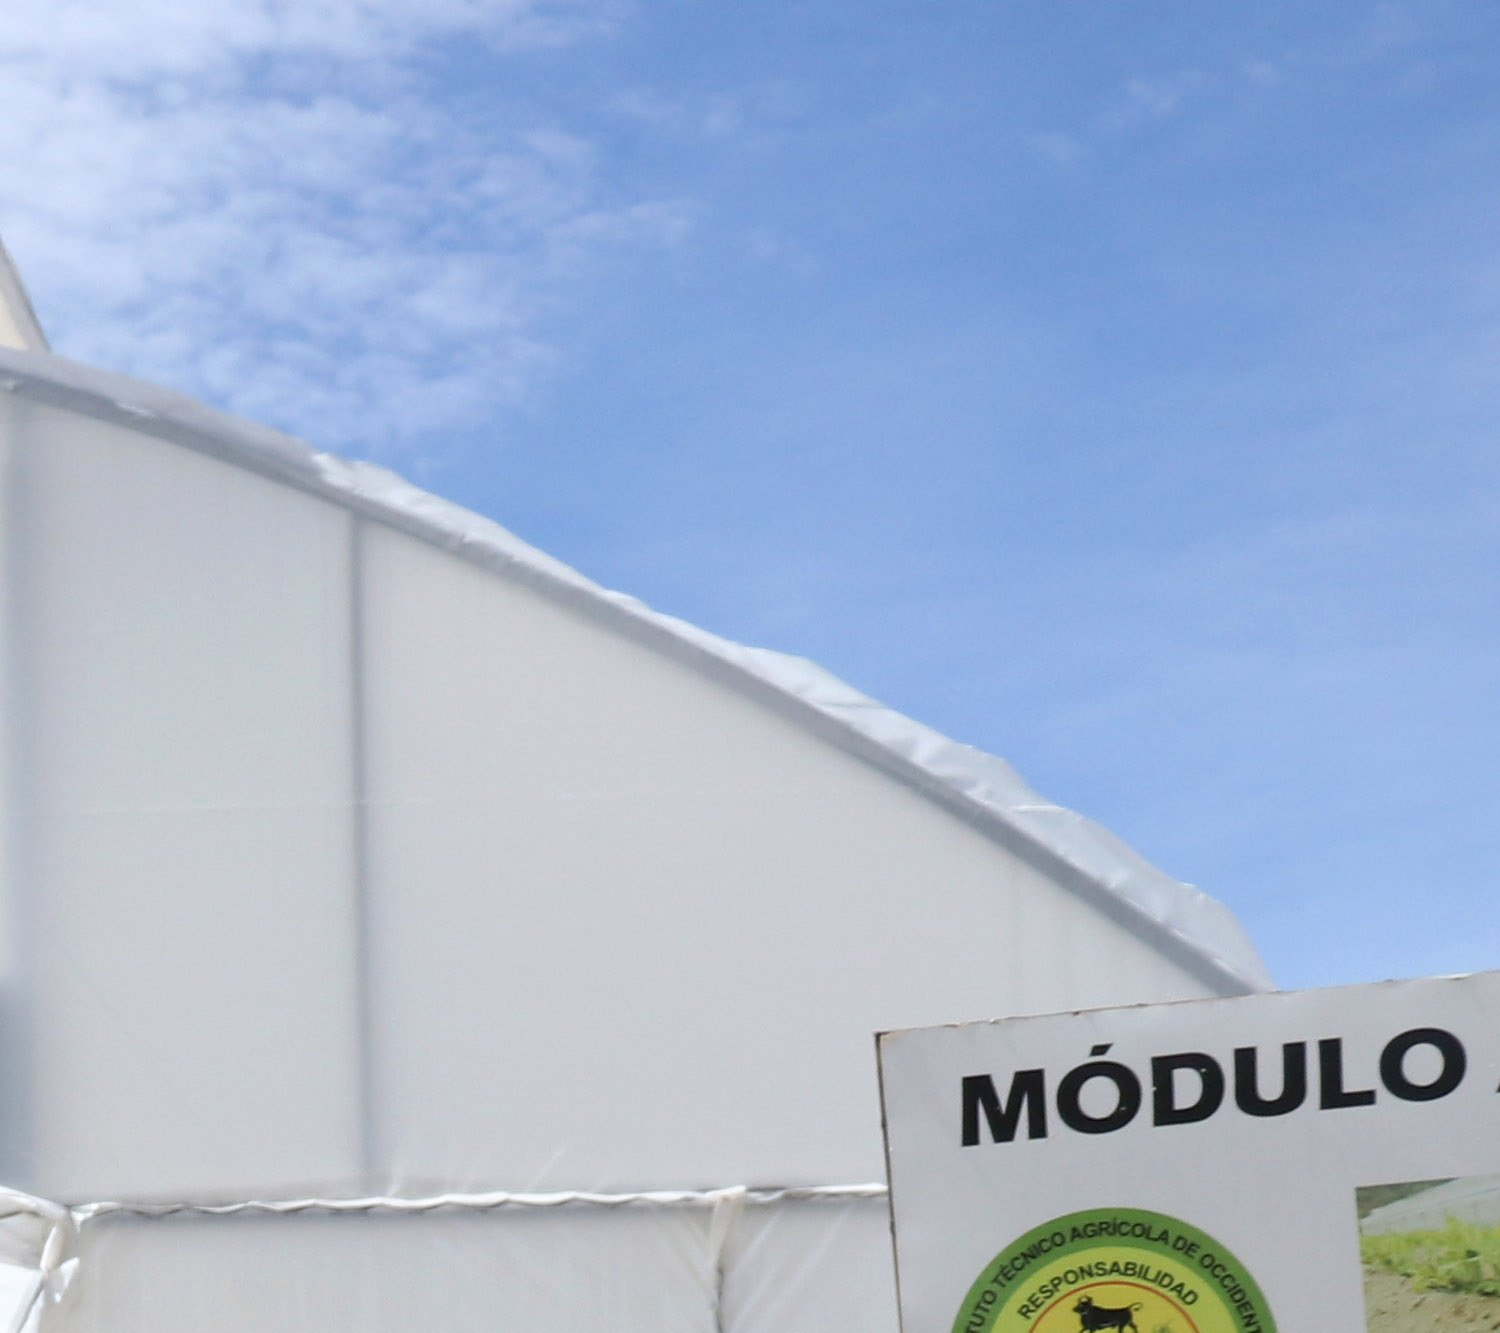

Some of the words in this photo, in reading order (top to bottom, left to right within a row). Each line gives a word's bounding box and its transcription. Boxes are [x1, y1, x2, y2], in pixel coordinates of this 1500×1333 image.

[961, 1027, 1467, 1147] MÓDULO
[992, 1232, 1067, 1288] TÉCNICO
[1070, 1217, 1170, 1246] AGRÍCOLA
[1172, 1235, 1200, 1260] DE
[1017, 1261, 1198, 1320] RESPONSABILIDAD
